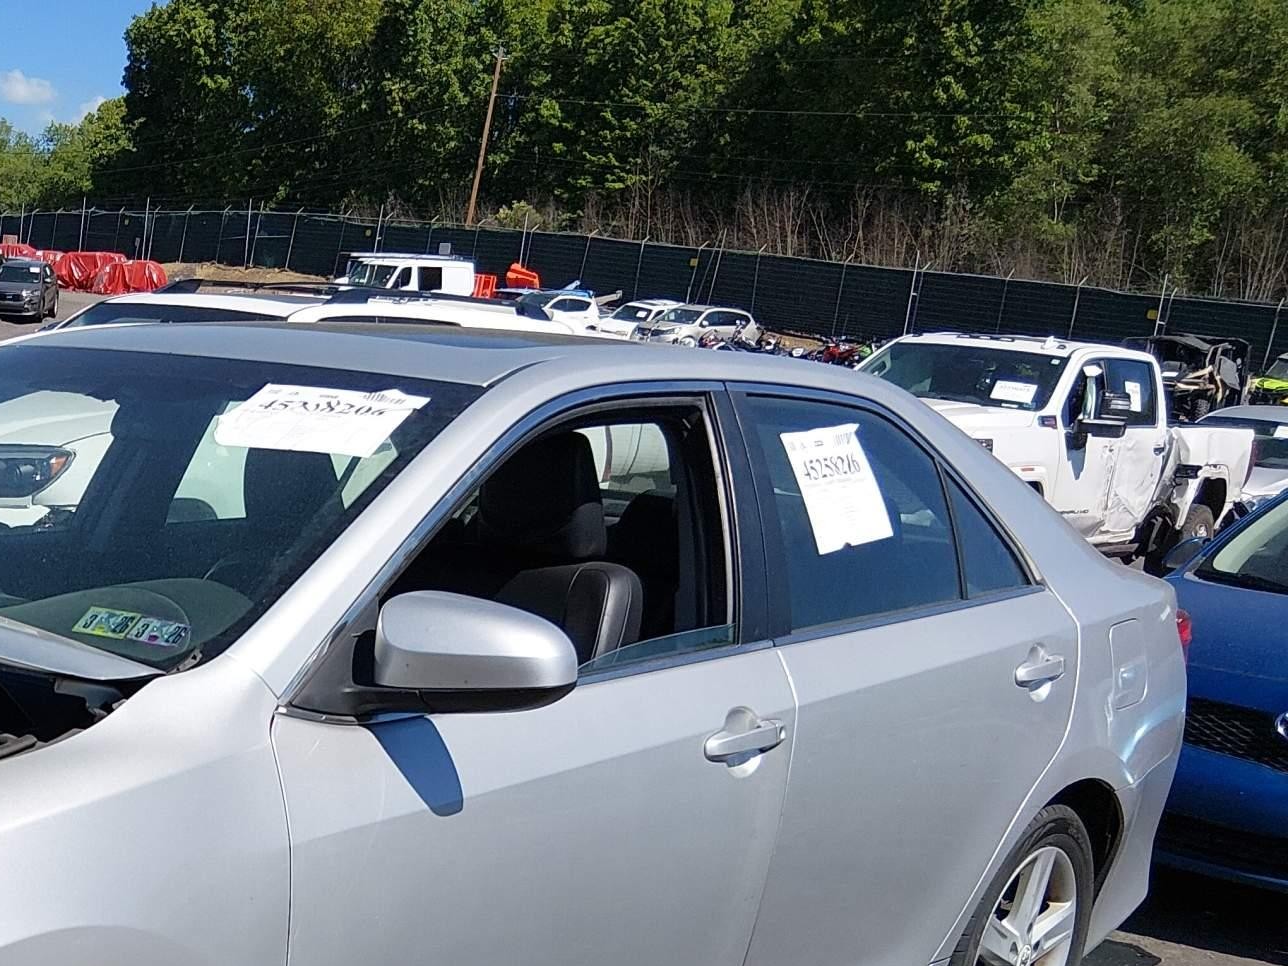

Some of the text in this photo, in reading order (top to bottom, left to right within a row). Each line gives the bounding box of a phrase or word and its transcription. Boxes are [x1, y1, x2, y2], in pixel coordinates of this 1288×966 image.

[83, 614, 136, 634] 3 26
[135, 623, 188, 644] 3 26
